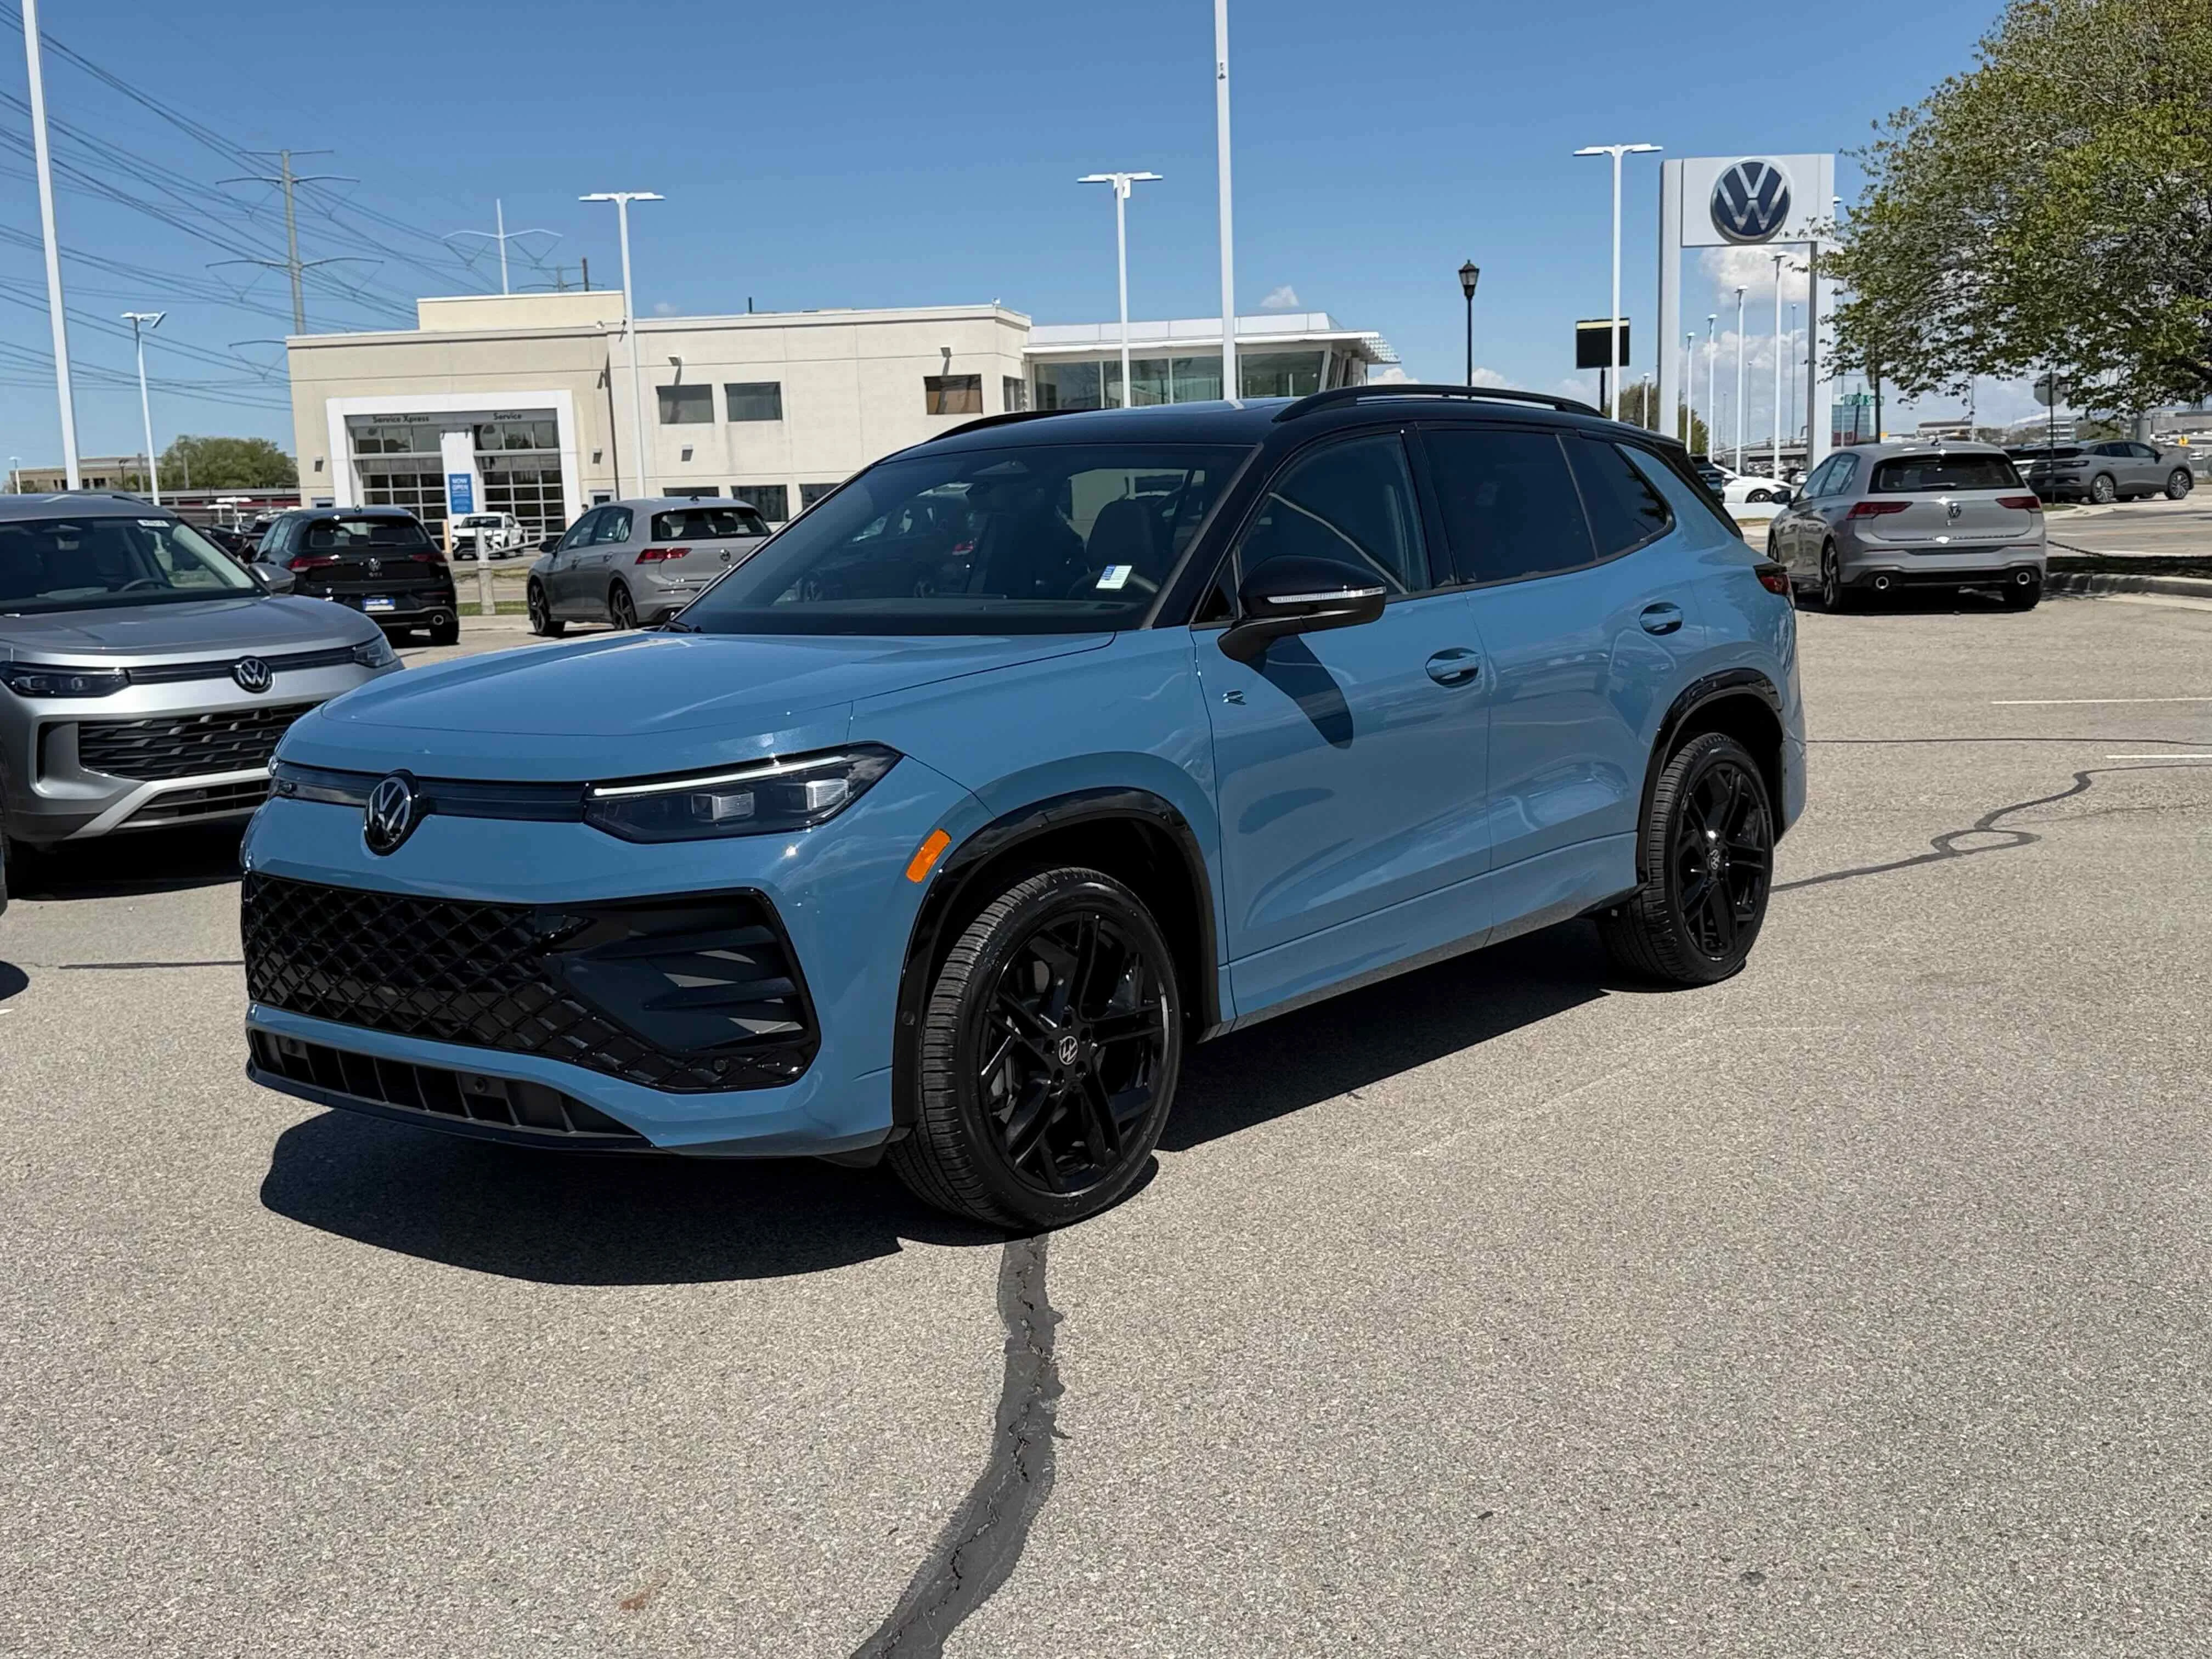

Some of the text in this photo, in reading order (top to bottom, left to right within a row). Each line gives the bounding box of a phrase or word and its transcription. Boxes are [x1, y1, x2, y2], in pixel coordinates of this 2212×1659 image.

[1712, 159, 1790, 237] VW
[403, 415, 430, 423] Xpress
[493, 412, 522, 420] Service
